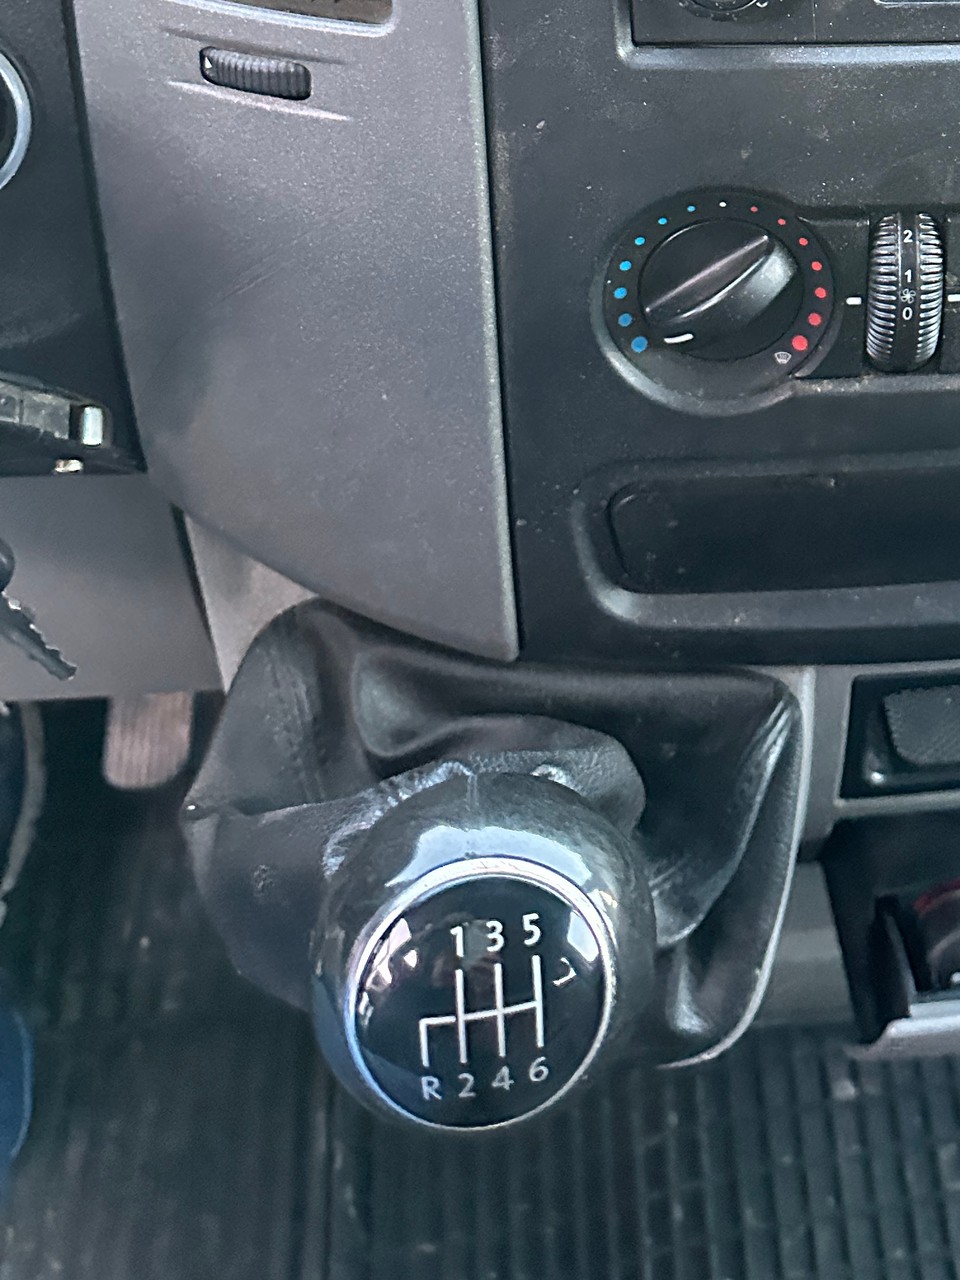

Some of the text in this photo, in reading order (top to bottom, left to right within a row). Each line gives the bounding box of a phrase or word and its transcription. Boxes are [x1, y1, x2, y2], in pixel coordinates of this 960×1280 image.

[903, 230, 913, 243] 2
[904, 269, 912, 283] 1
[903, 307, 912, 320] 0
[450, 913, 542, 957] 1 3 5
[421, 1055, 550, 1101] R 2 4 6
